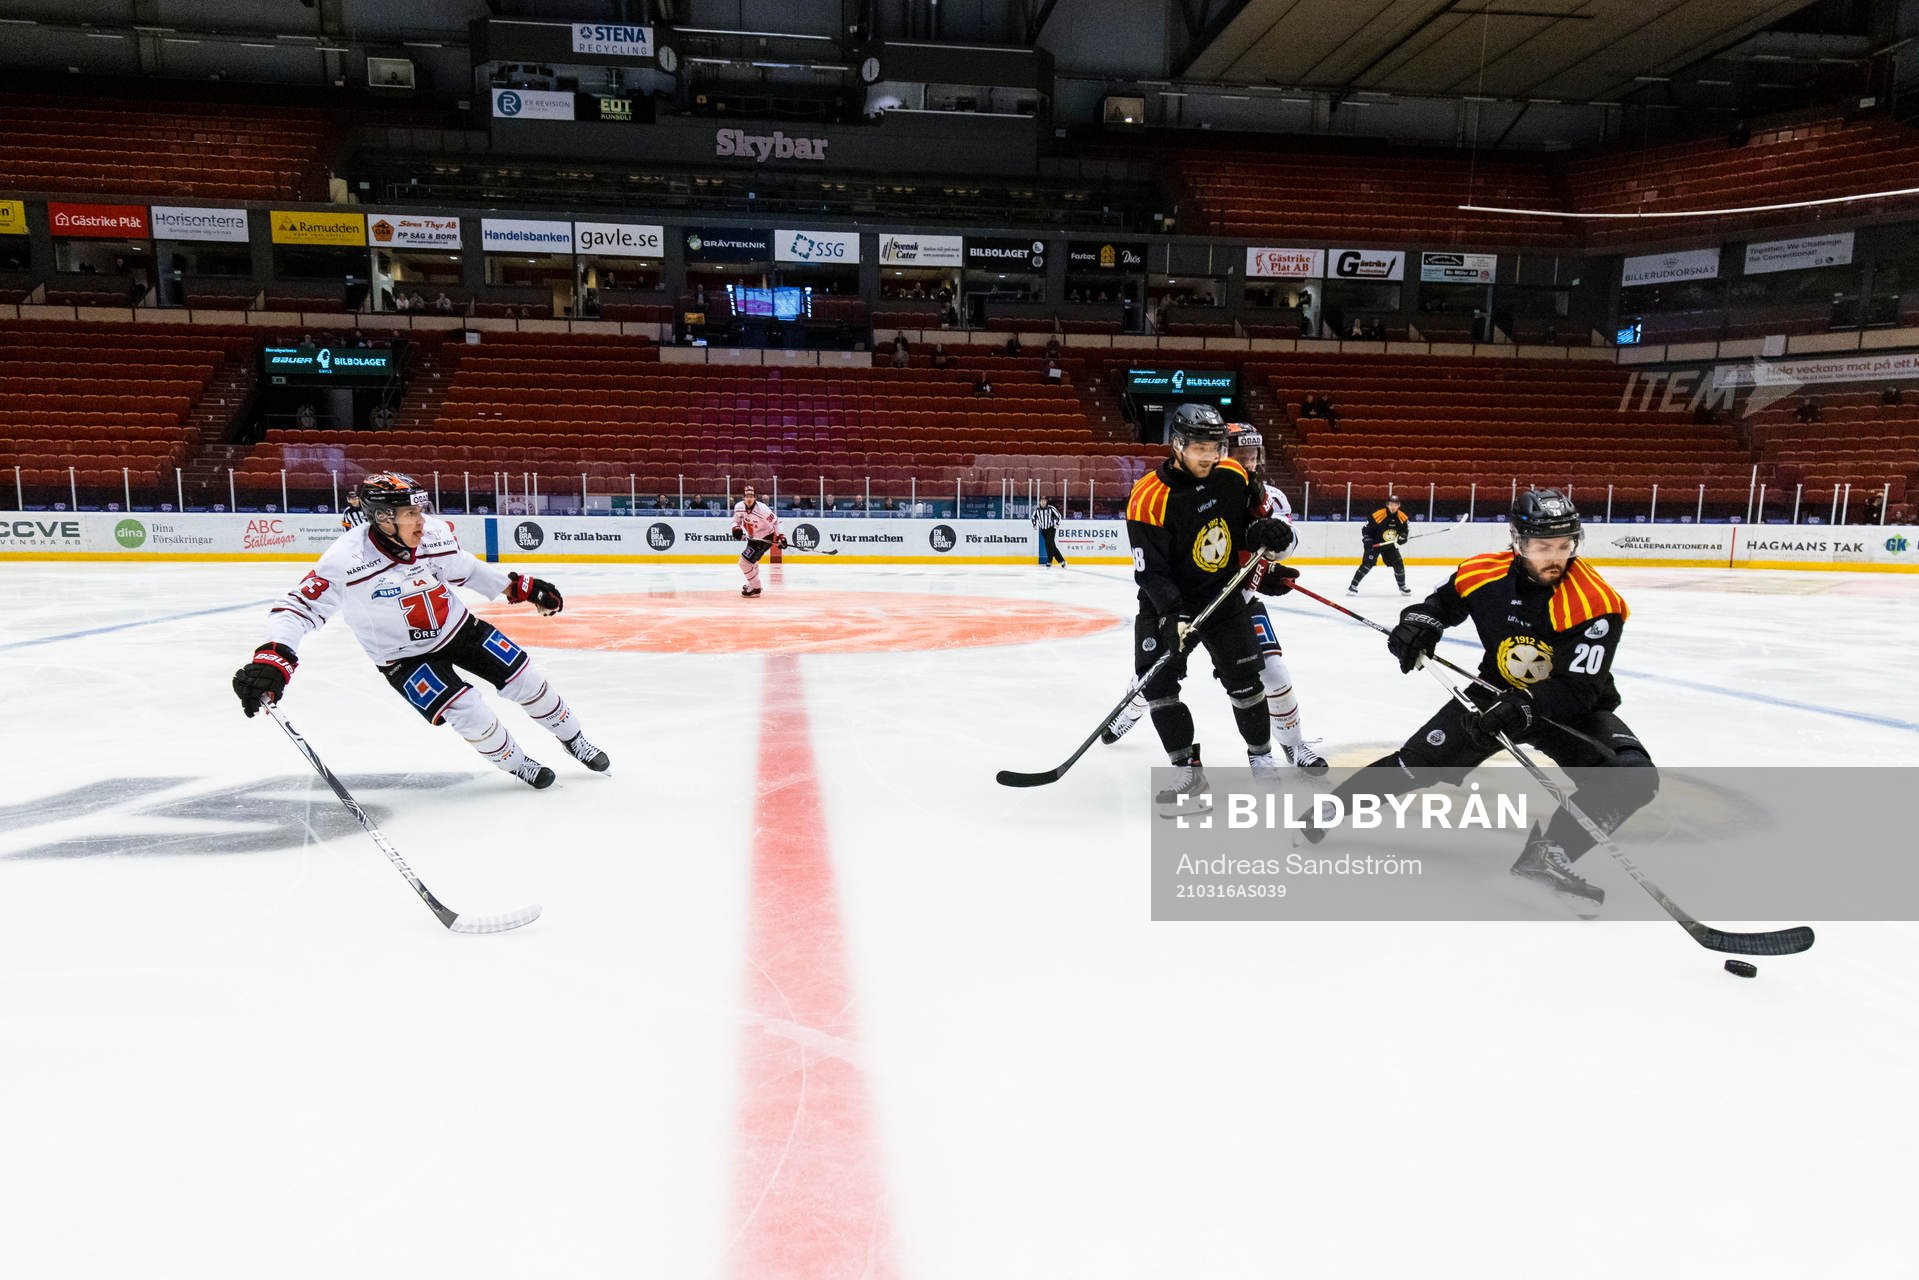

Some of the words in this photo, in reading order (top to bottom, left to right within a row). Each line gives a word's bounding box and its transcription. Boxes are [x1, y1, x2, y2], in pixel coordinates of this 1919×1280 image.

[594, 26, 647, 43] STENA
[578, 43, 648, 55] RECYCLING
[715, 128, 830, 163] Skybar
[70, 215, 118, 227] Gästrike
[119, 216, 142, 229] Plåt
[155, 212, 245, 228] Horisonterra
[299, 221, 360, 234] Ramudden
[397, 231, 409, 239] PP
[435, 233, 458, 241] BORR
[484, 229, 571, 243] Handelsbanken
[580, 228, 659, 250] gavle.se
[702, 238, 767, 249] GRÄVTEKNIK
[892, 240, 919, 251] Svensk
[815, 241, 845, 258] SSG
[896, 250, 917, 260] Cater
[969, 247, 1030, 259] BILBOLAGET
[1268, 252, 1312, 263] Gästrike
[1293, 262, 1309, 272] AB
[334, 357, 388, 366] BILBOLAGET
[1796, 363, 1844, 375] veckans
[1847, 362, 1870, 373] mat
[1874, 358, 1891, 372] på
[1894, 358, 1912, 369] ett
[1186, 377, 1232, 388] BILBOLAGET
[1618, 369, 1738, 412] ITEM
[152, 523, 174, 534] Dina
[245, 519, 284, 535] ABC
[796, 527, 805, 535] EN
[116, 527, 145, 539] dina
[554, 531, 571, 542] För
[573, 531, 595, 542] alla
[596, 531, 622, 542] barn
[684, 532, 702, 542] För
[829, 533, 841, 543] Vi
[843, 534, 861, 543] tar
[863, 533, 904, 543] matchen
[965, 533, 982, 543] För
[984, 533, 1004, 543] alla
[1005, 533, 1028, 543] barn
[1058, 529, 1118, 538] BERENDSEN
[152, 533, 215, 545] Försäkringar
[243, 533, 297, 550] Ställningar
[519, 538, 540, 546] START
[650, 539, 671, 548] START
[796, 540, 816, 548] START
[1886, 538, 1907, 551] GK
[1624, 542, 1710, 550] PALLREPARATIONER
[1747, 540, 1828, 552] HAGMANS
[1832, 542, 1864, 553] TAK
[380, 587, 401, 597] BRL
[1514, 635, 1537, 646] 1912
[1568, 643, 1605, 675] 20
